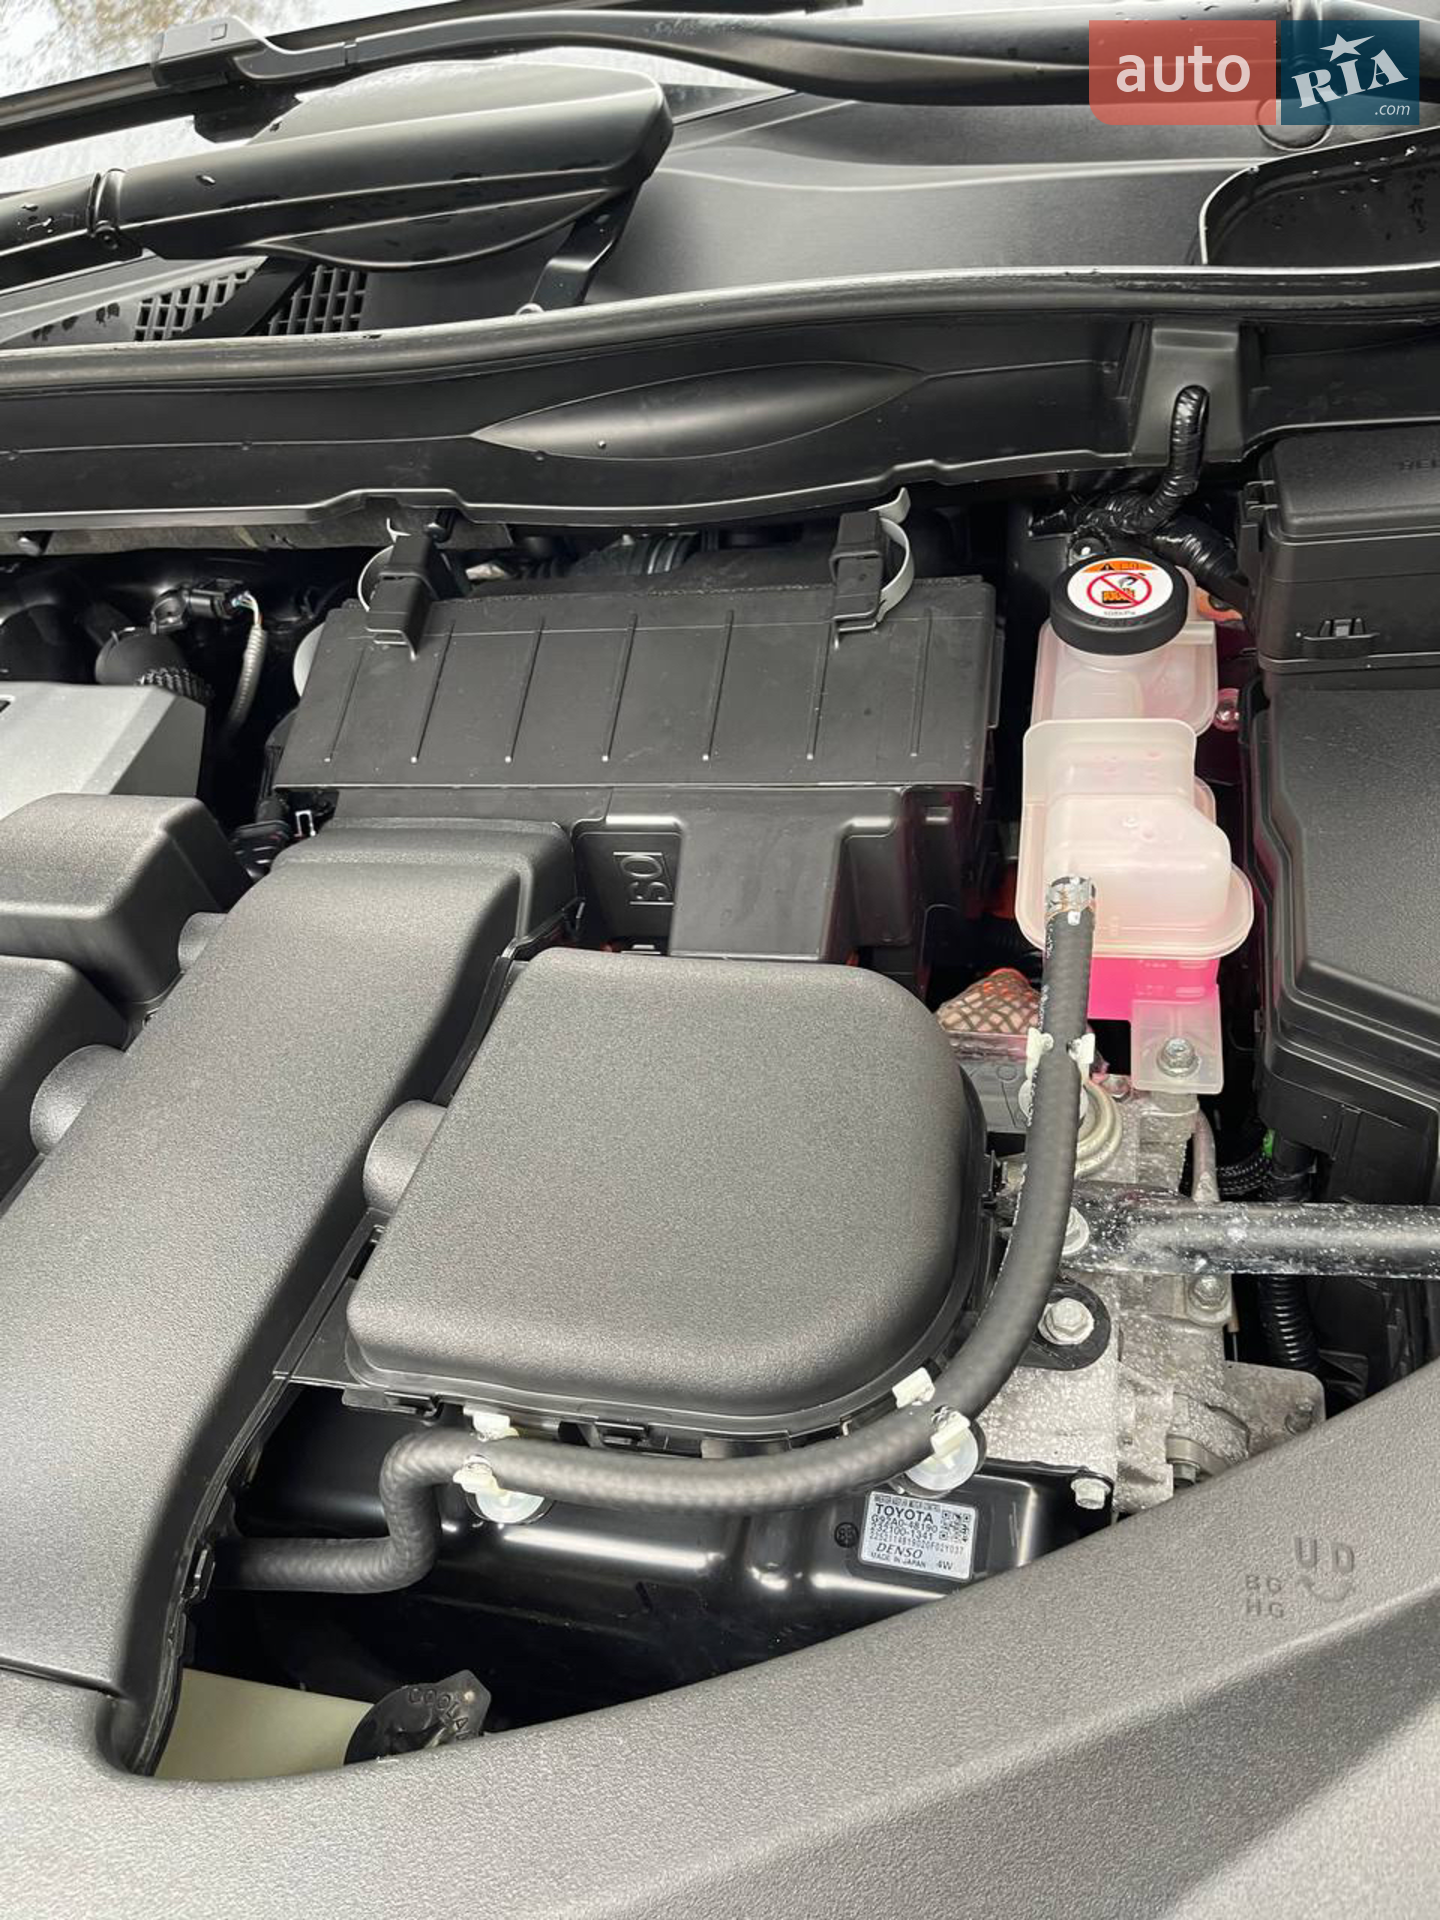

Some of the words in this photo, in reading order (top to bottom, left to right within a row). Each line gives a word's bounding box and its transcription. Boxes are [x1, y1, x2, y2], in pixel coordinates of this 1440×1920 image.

[875, 1503, 934, 1524] TOYOTA
[876, 1542, 923, 1559] DENSO
[871, 1552, 889, 1561] MADE
[902, 1557, 926, 1568] JAPAN
